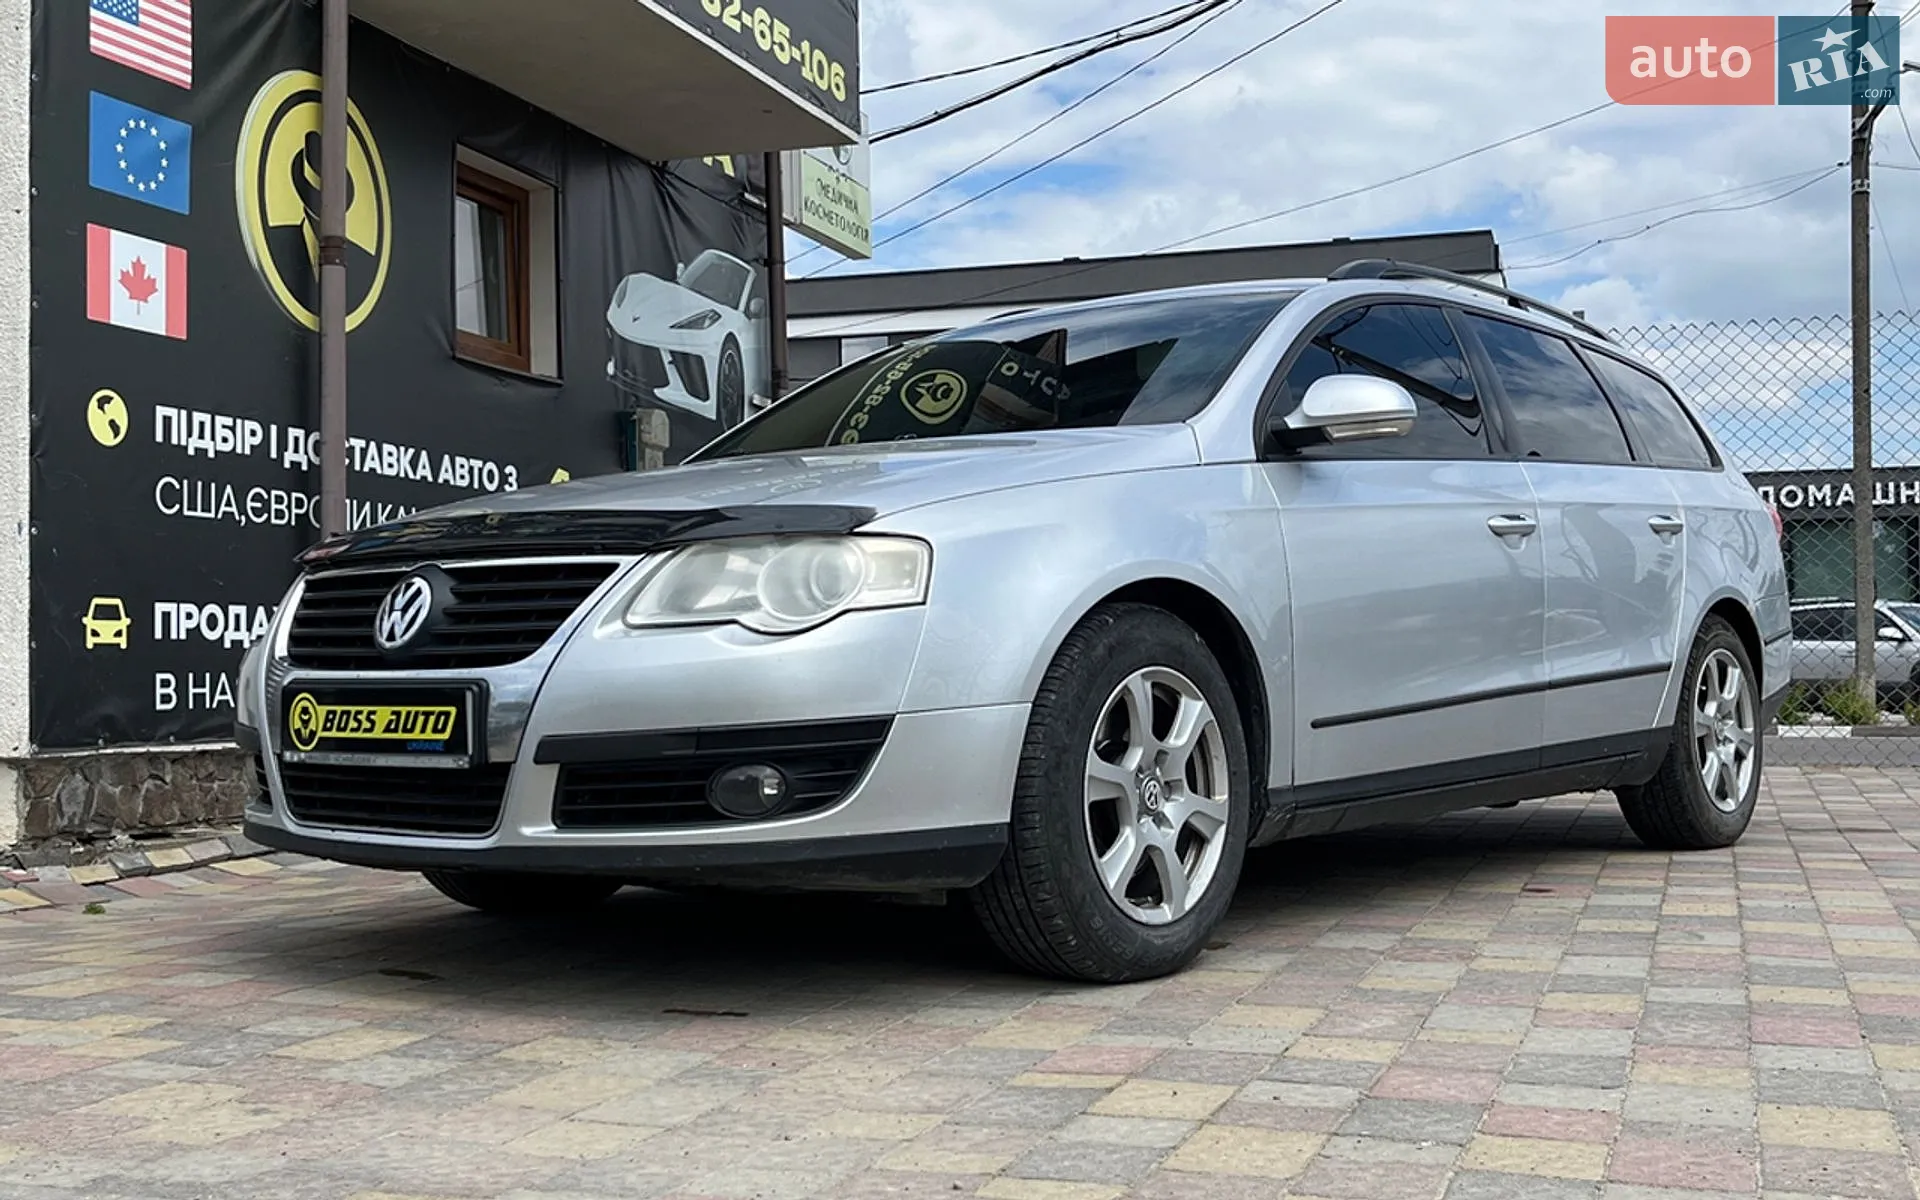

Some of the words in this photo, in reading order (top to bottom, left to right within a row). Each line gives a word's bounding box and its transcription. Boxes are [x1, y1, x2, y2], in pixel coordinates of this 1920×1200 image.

[155, 405, 264, 459] ПІДБІР
[269, 423, 278, 460] І
[283, 427, 433, 482] ДОТАВКА
[437, 454, 500, 492] АВТО
[154, 602, 278, 649] ПРОДА
[155, 672, 178, 711] В
[188, 671, 238, 709] НА
[321, 709, 378, 733] BOSS
[382, 710, 451, 734] AUTO
